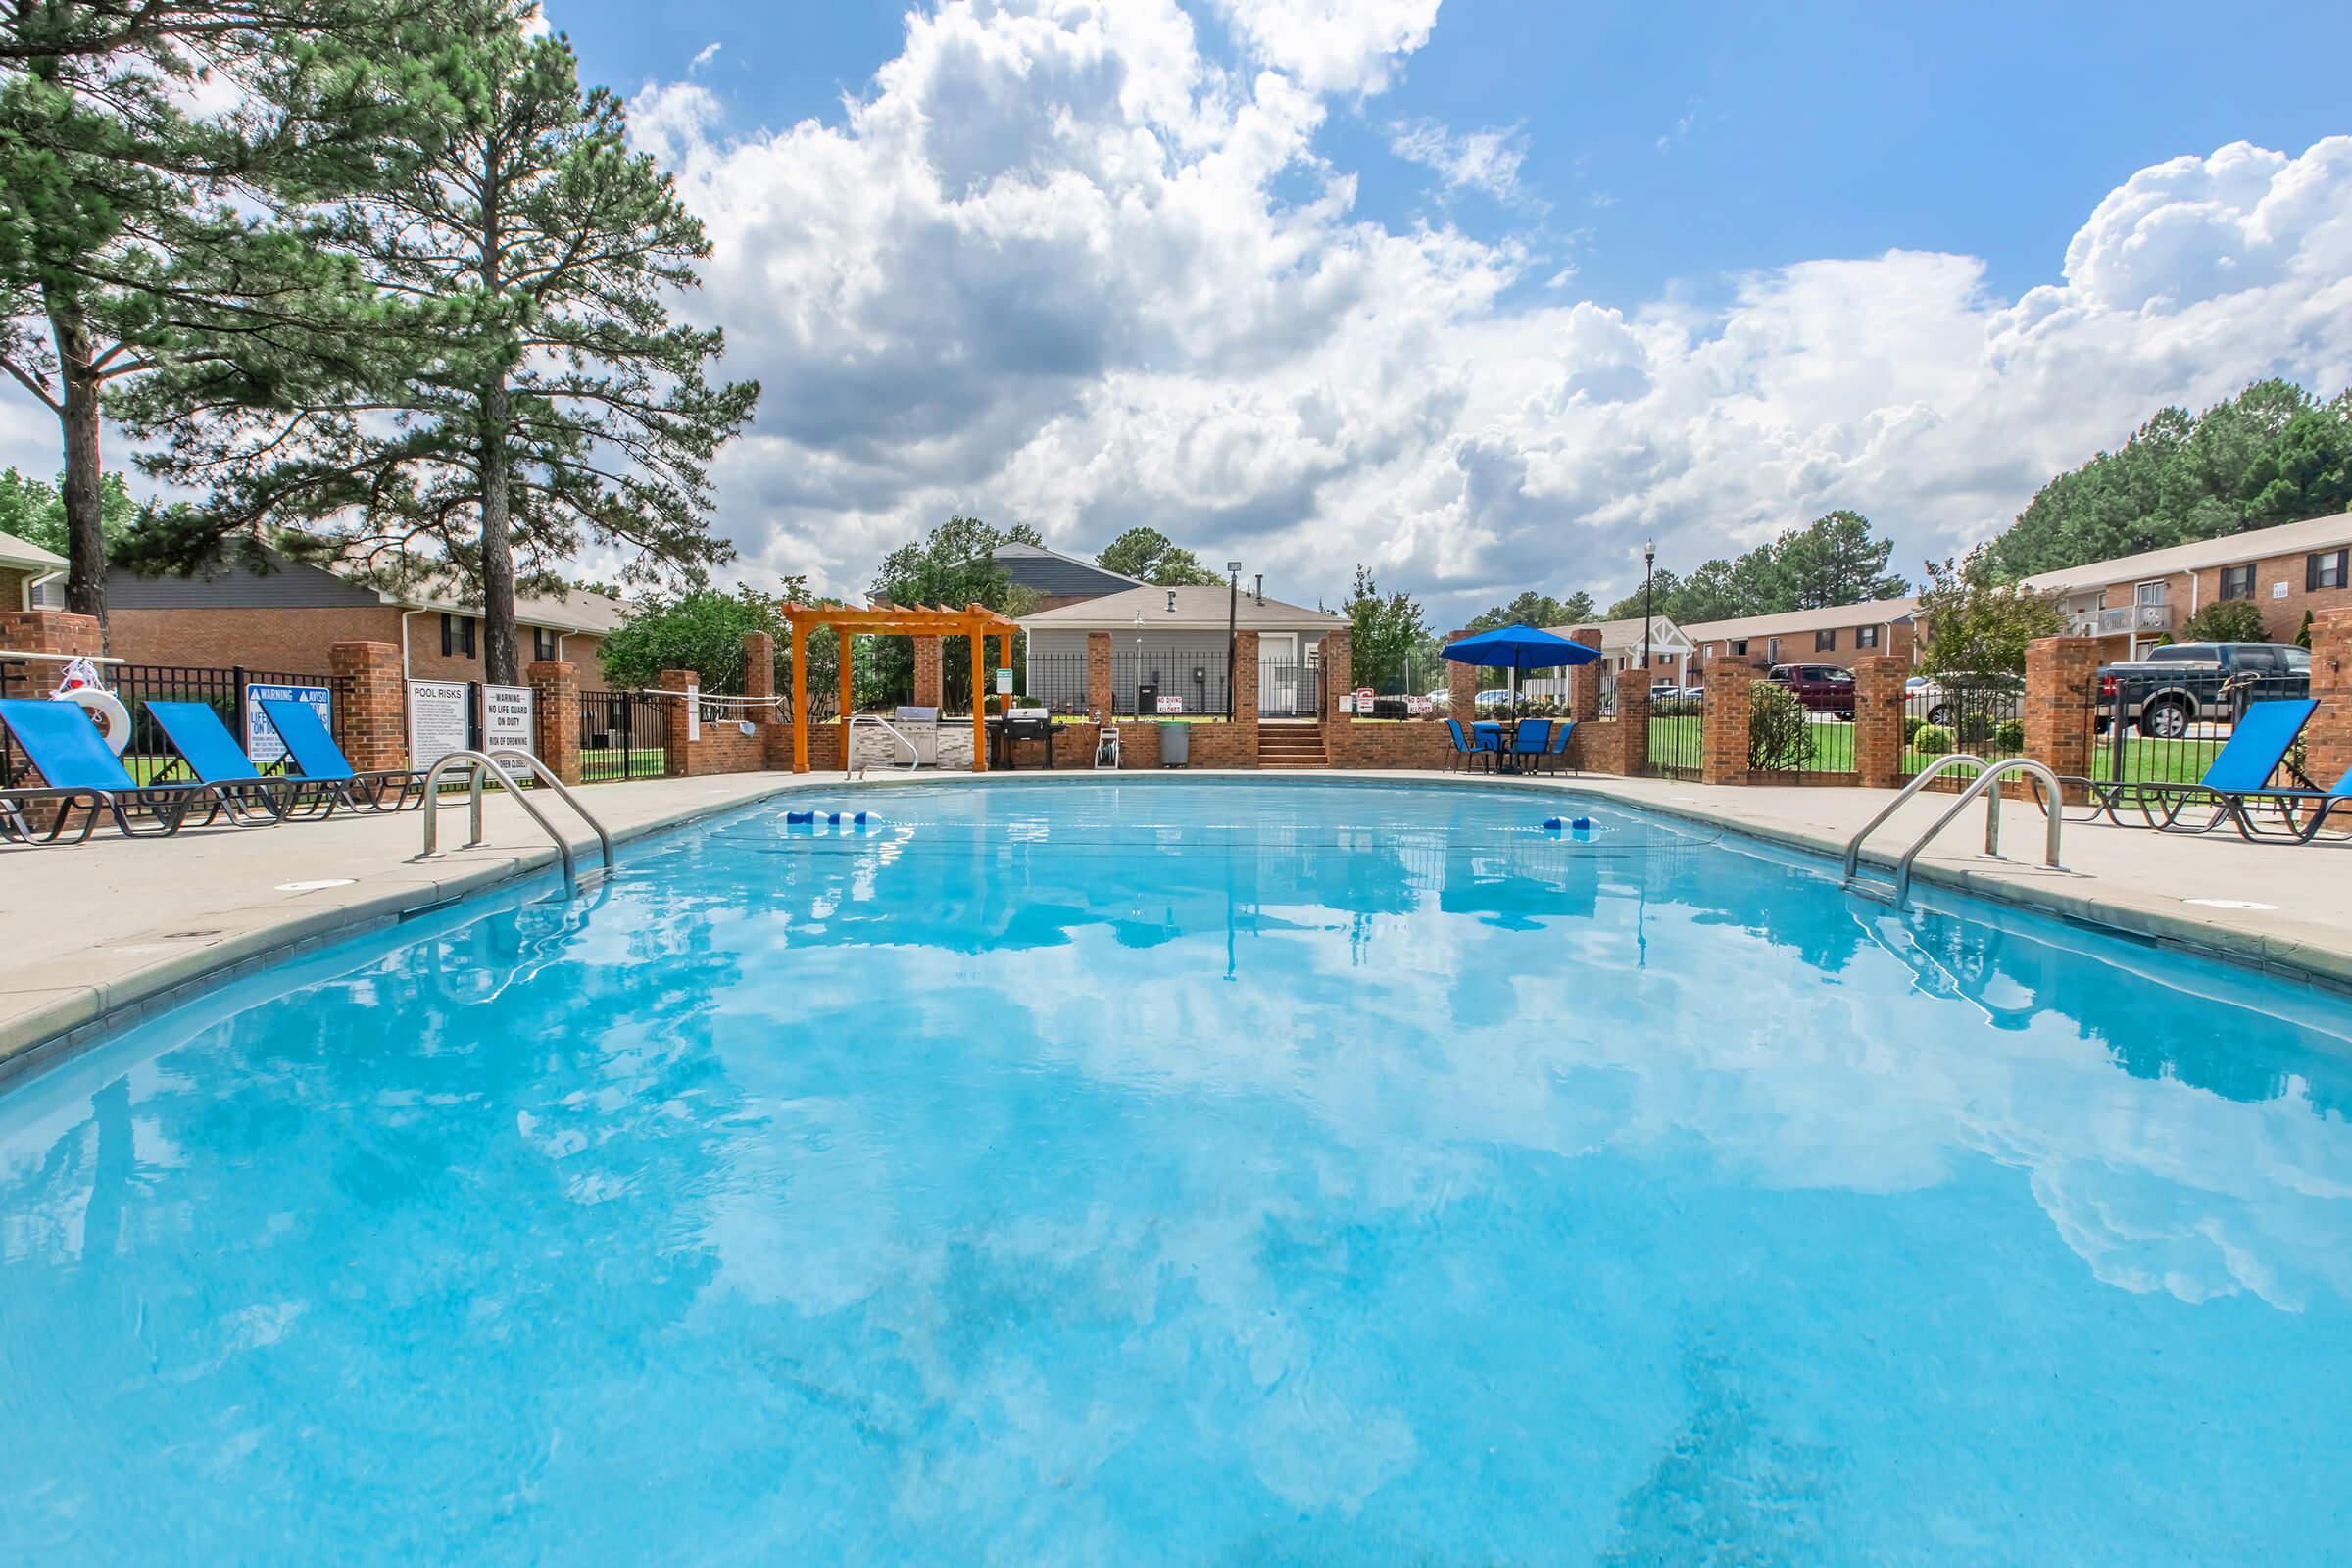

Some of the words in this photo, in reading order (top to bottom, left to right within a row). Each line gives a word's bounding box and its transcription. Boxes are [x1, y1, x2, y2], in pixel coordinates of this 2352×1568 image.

[261, 689, 293, 701] WARNING
[309, 691, 327, 702] AVISO
[415, 688, 437, 698] POOL
[438, 689, 462, 699] RISKS
[496, 693, 520, 703] WARNING
[489, 705, 496, 714] NO
[498, 705, 510, 714] LIFE
[510, 706, 528, 714] GUARD
[498, 717, 505, 726] ON
[507, 717, 520, 726] DUTY
[489, 737, 499, 745] RISK
[500, 737, 505, 745] OF
[506, 737, 528, 745] DROWNING
